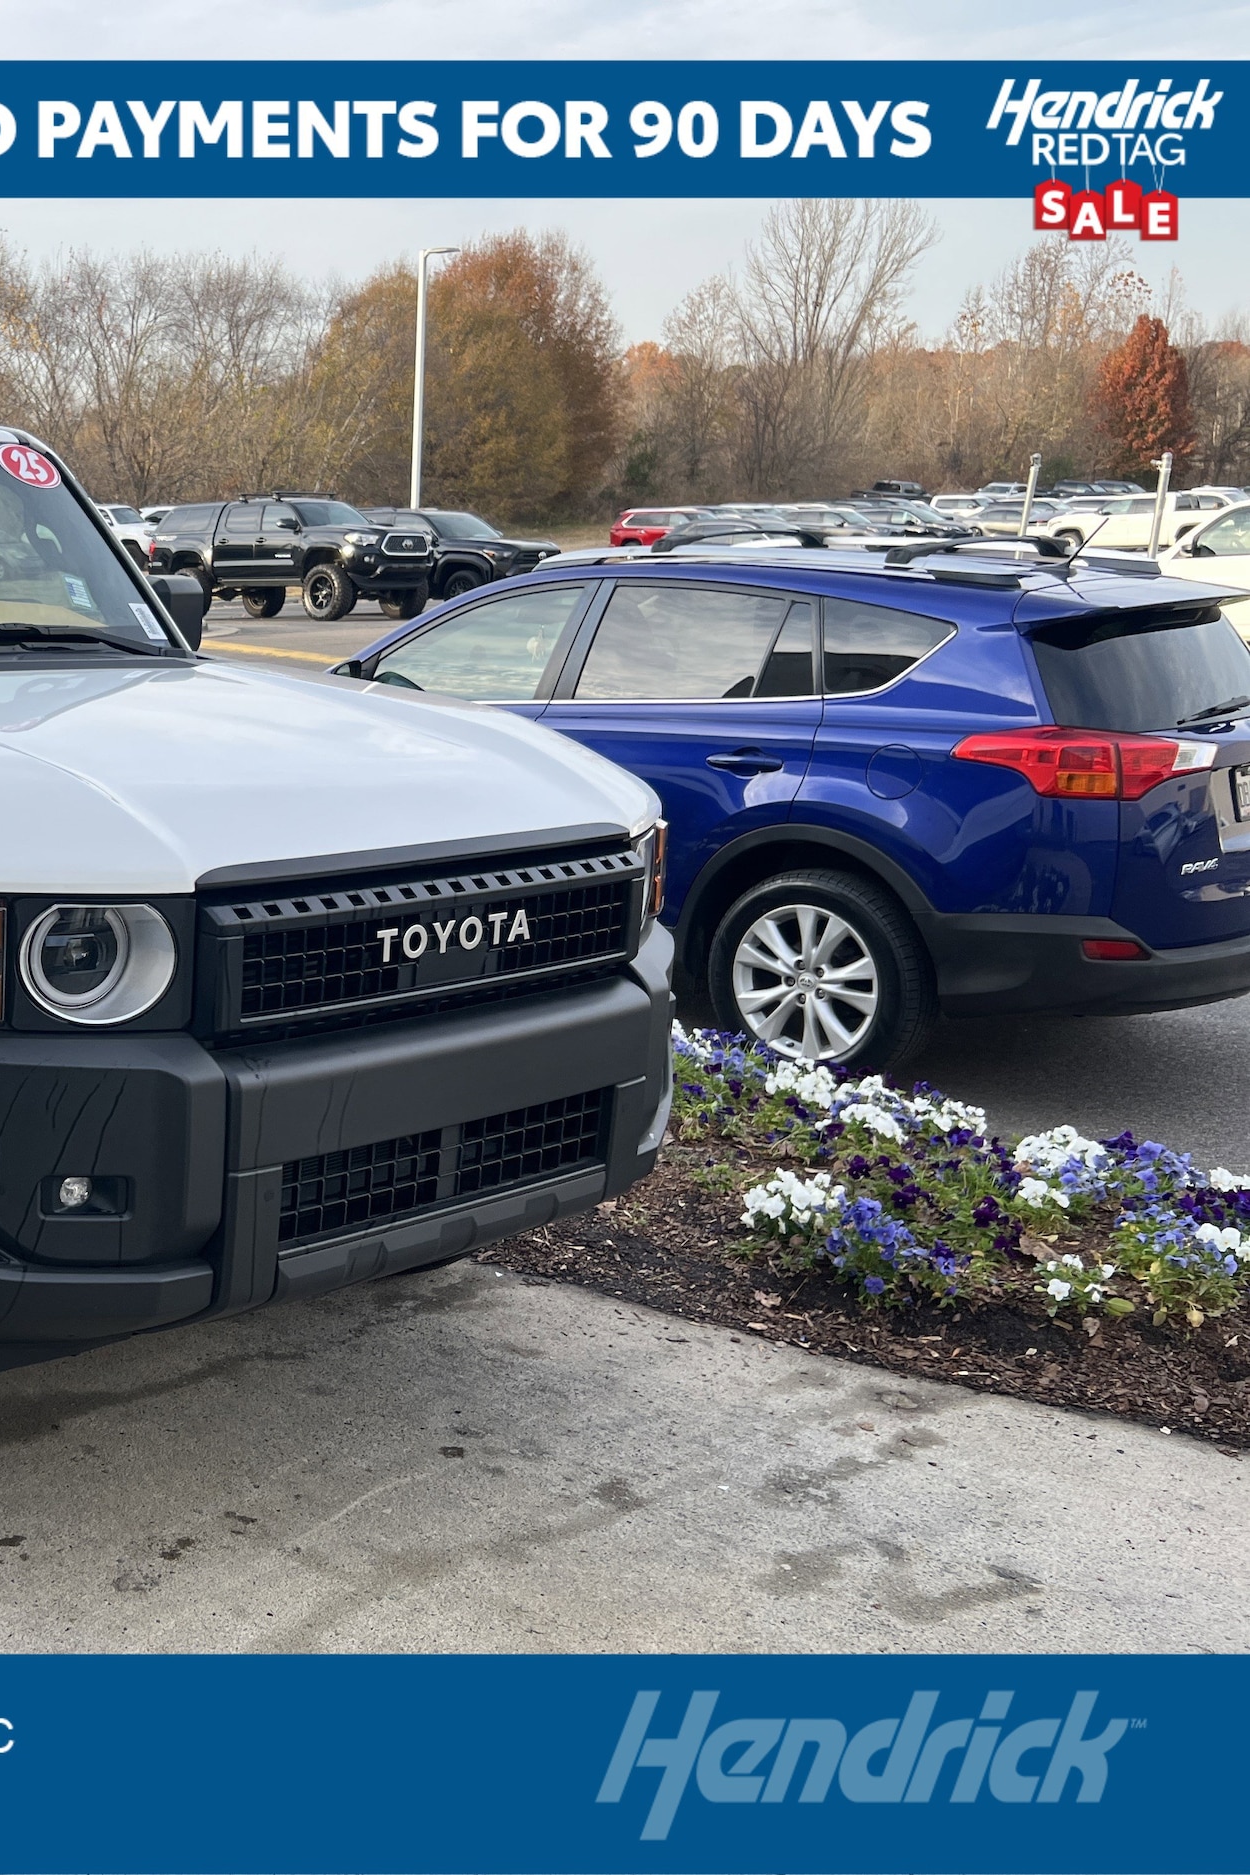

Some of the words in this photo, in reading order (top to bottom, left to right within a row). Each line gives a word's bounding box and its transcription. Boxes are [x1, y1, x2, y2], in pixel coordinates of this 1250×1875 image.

[10, 449, 48, 482] 25
[1181, 858, 1218, 875] RAV4
[376, 909, 531, 963] TOYOTA
